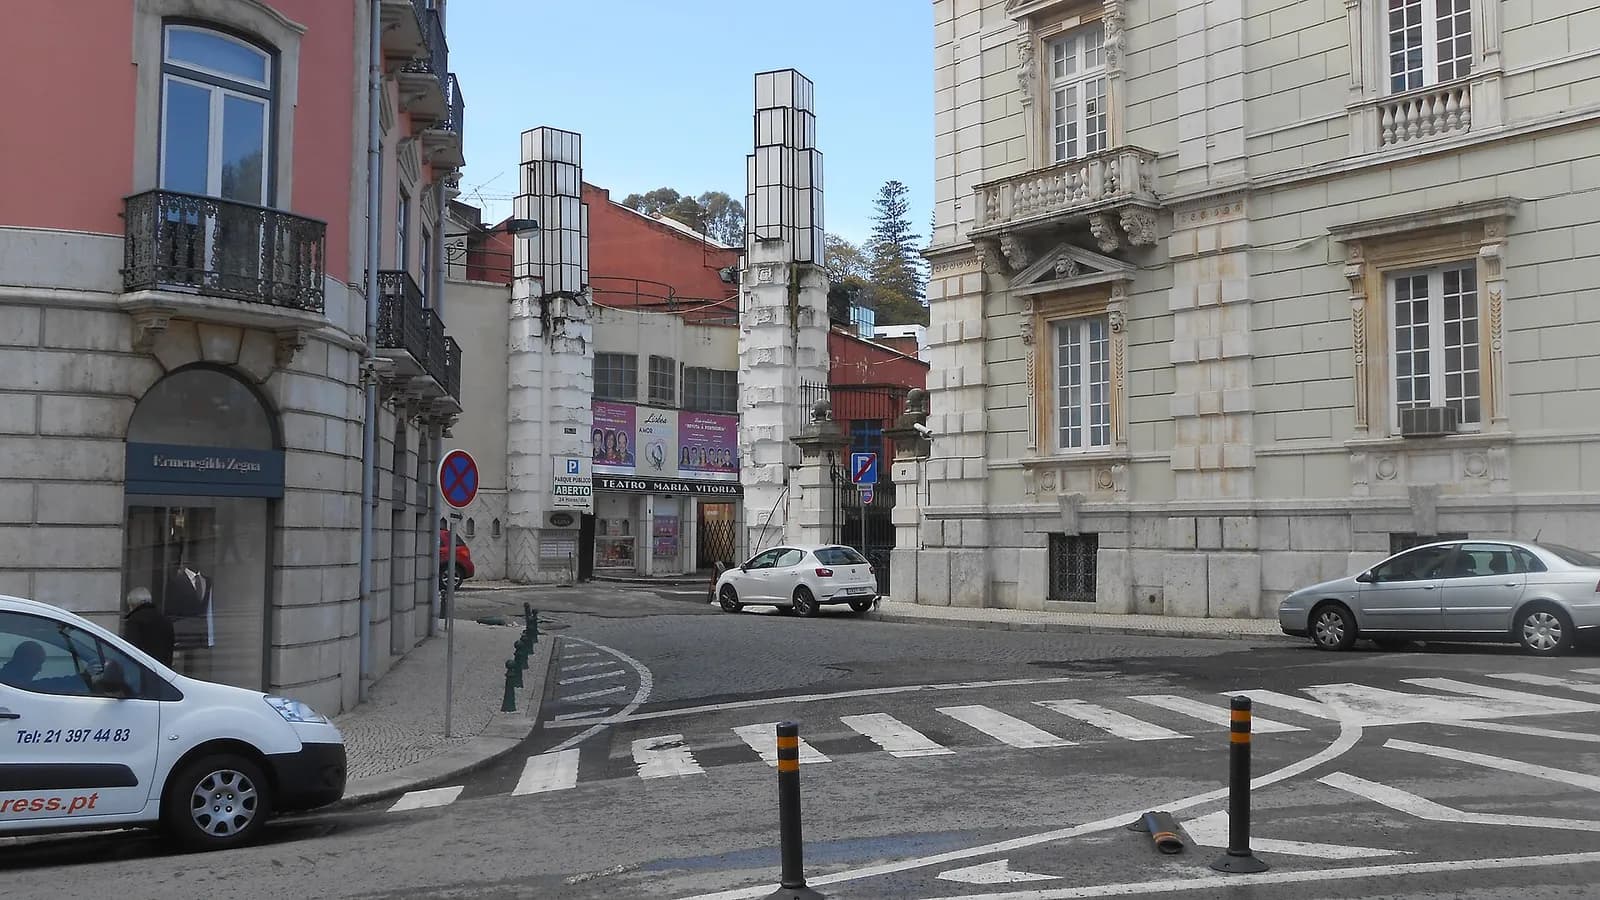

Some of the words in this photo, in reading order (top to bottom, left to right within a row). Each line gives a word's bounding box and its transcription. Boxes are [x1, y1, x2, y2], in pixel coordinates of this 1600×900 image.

[153, 454, 226, 472] Ermenegildo
[226, 457, 261, 474] Zegna
[569, 460, 577, 473] P
[554, 476, 572, 484] PARQUE
[602, 480, 646, 490] TEATRO
[653, 483, 690, 492] MARIA
[556, 486, 590, 495] ABERTO
[16, 730, 41, 743] Tel:
[44, 729, 61, 743] 21
[65, 729, 91, 742] 397
[93, 729, 111, 742] 44
[113, 728, 130, 742] 83
[0, 792, 99, 814] ress.pt
